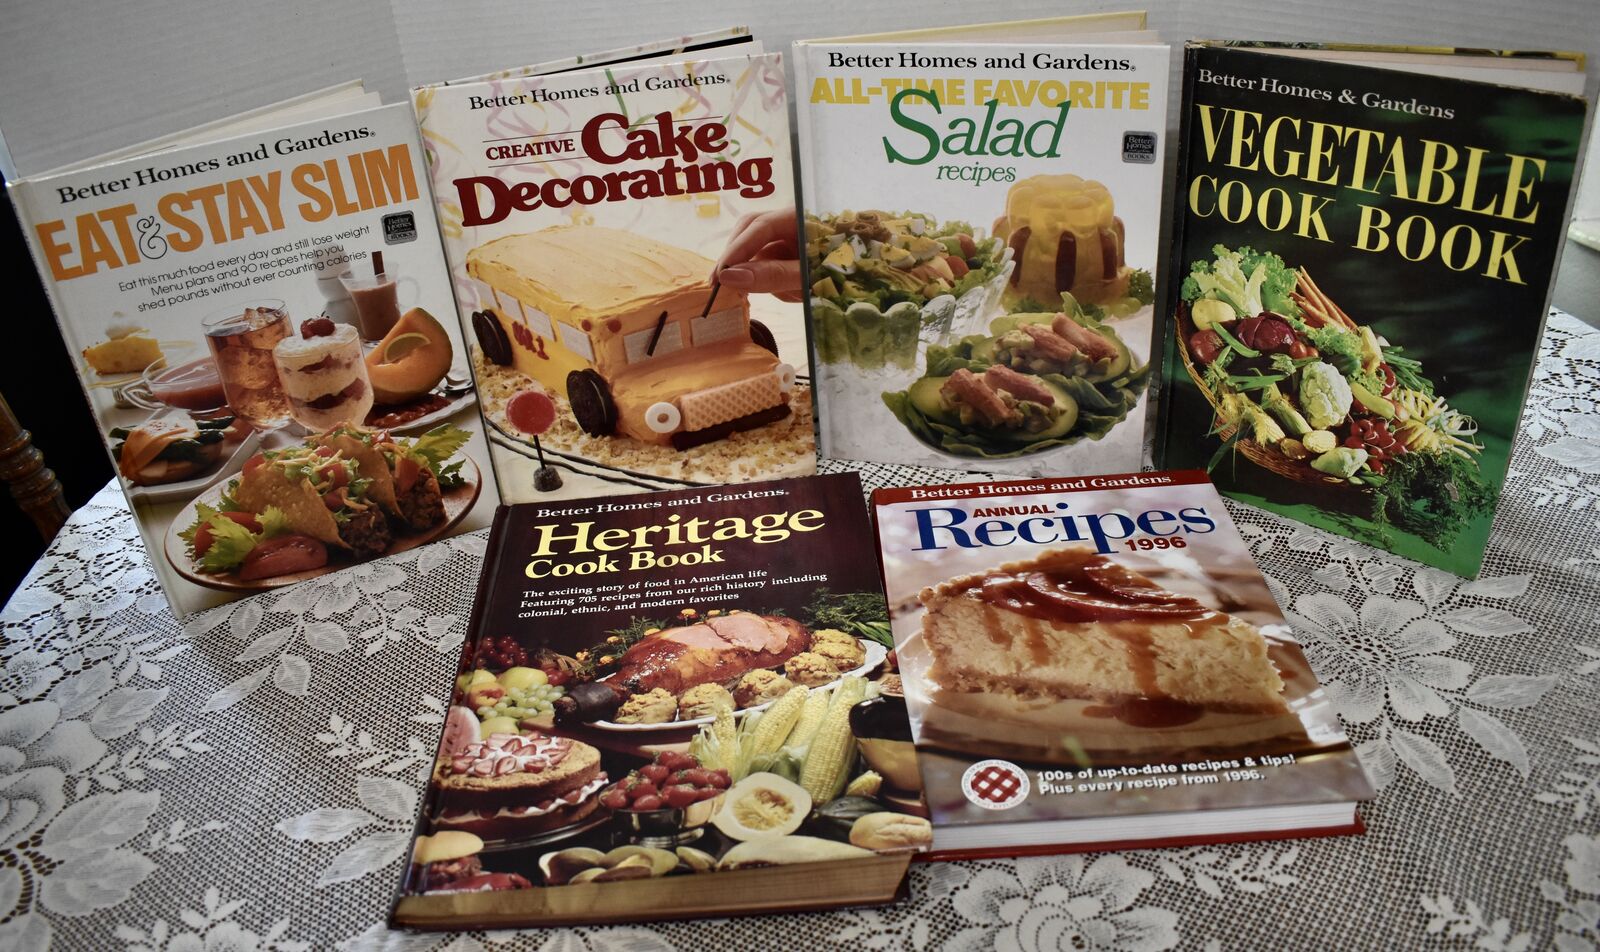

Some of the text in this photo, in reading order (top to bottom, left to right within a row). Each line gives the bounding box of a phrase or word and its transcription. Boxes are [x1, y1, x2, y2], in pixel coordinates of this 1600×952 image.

[828, 52, 894, 69] Better
[898, 52, 977, 69] Homes
[984, 53, 1025, 69] and
[469, 92, 527, 111] Better
[531, 84, 600, 103] Homes
[604, 78, 641, 96] and
[809, 77, 1151, 110] ALL-TIME FAVORITE
[1198, 68, 1455, 120] Better Homes & Gardens
[485, 111, 728, 165] CREATIVE Cake
[882, 88, 1072, 166] Salad
[56, 178, 131, 204] Better
[134, 157, 220, 187] Homes
[227, 143, 270, 167] and
[936, 163, 1016, 187] recipes
[1196, 103, 1546, 224] VEGETABLE
[452, 157, 775, 227] Decorating
[35, 204, 141, 281] EAT
[157, 170, 287, 253] STAY
[290, 144, 420, 224] SLIM
[1189, 174, 1532, 285] COOK BOOK
[118, 225, 370, 292] Eat this much food every day and still lose weight
[151, 246, 344, 296] Menu plans and 90 recipes help you
[138, 250, 367, 312] shed pounds without ever counting calories
[911, 474, 1171, 500] Better Homes and Gardens
[536, 507, 593, 518] Better
[597, 501, 662, 514] Homes
[667, 496, 702, 508] and
[972, 504, 1055, 518] ANNUAL
[531, 509, 825, 557] Heritage
[905, 503, 1216, 556] Recipes
[1124, 537, 1187, 552] 1996
[525, 545, 725, 579] Cook Book
[520, 598, 575, 609] Featuring
[578, 595, 598, 604] 705
[600, 591, 642, 602] recipes
[645, 589, 672, 598] from
[700, 583, 722, 593] rich
[726, 579, 766, 591] history
[772, 573, 827, 585] including
[548, 586, 593, 598] exciting
[596, 583, 626, 594] story
[628, 581, 641, 590] of
[644, 578, 671, 588] food
[674, 577, 686, 585] in
[689, 573, 744, 584] American
[747, 569, 768, 578] life
[518, 593, 739, 619] colonial, ethnic, and modern favorites
[1037, 753, 1296, 782] 100s of up-to-date recipes & tips!
[1039, 768, 1265, 795] Plus every recipe from 1996.
